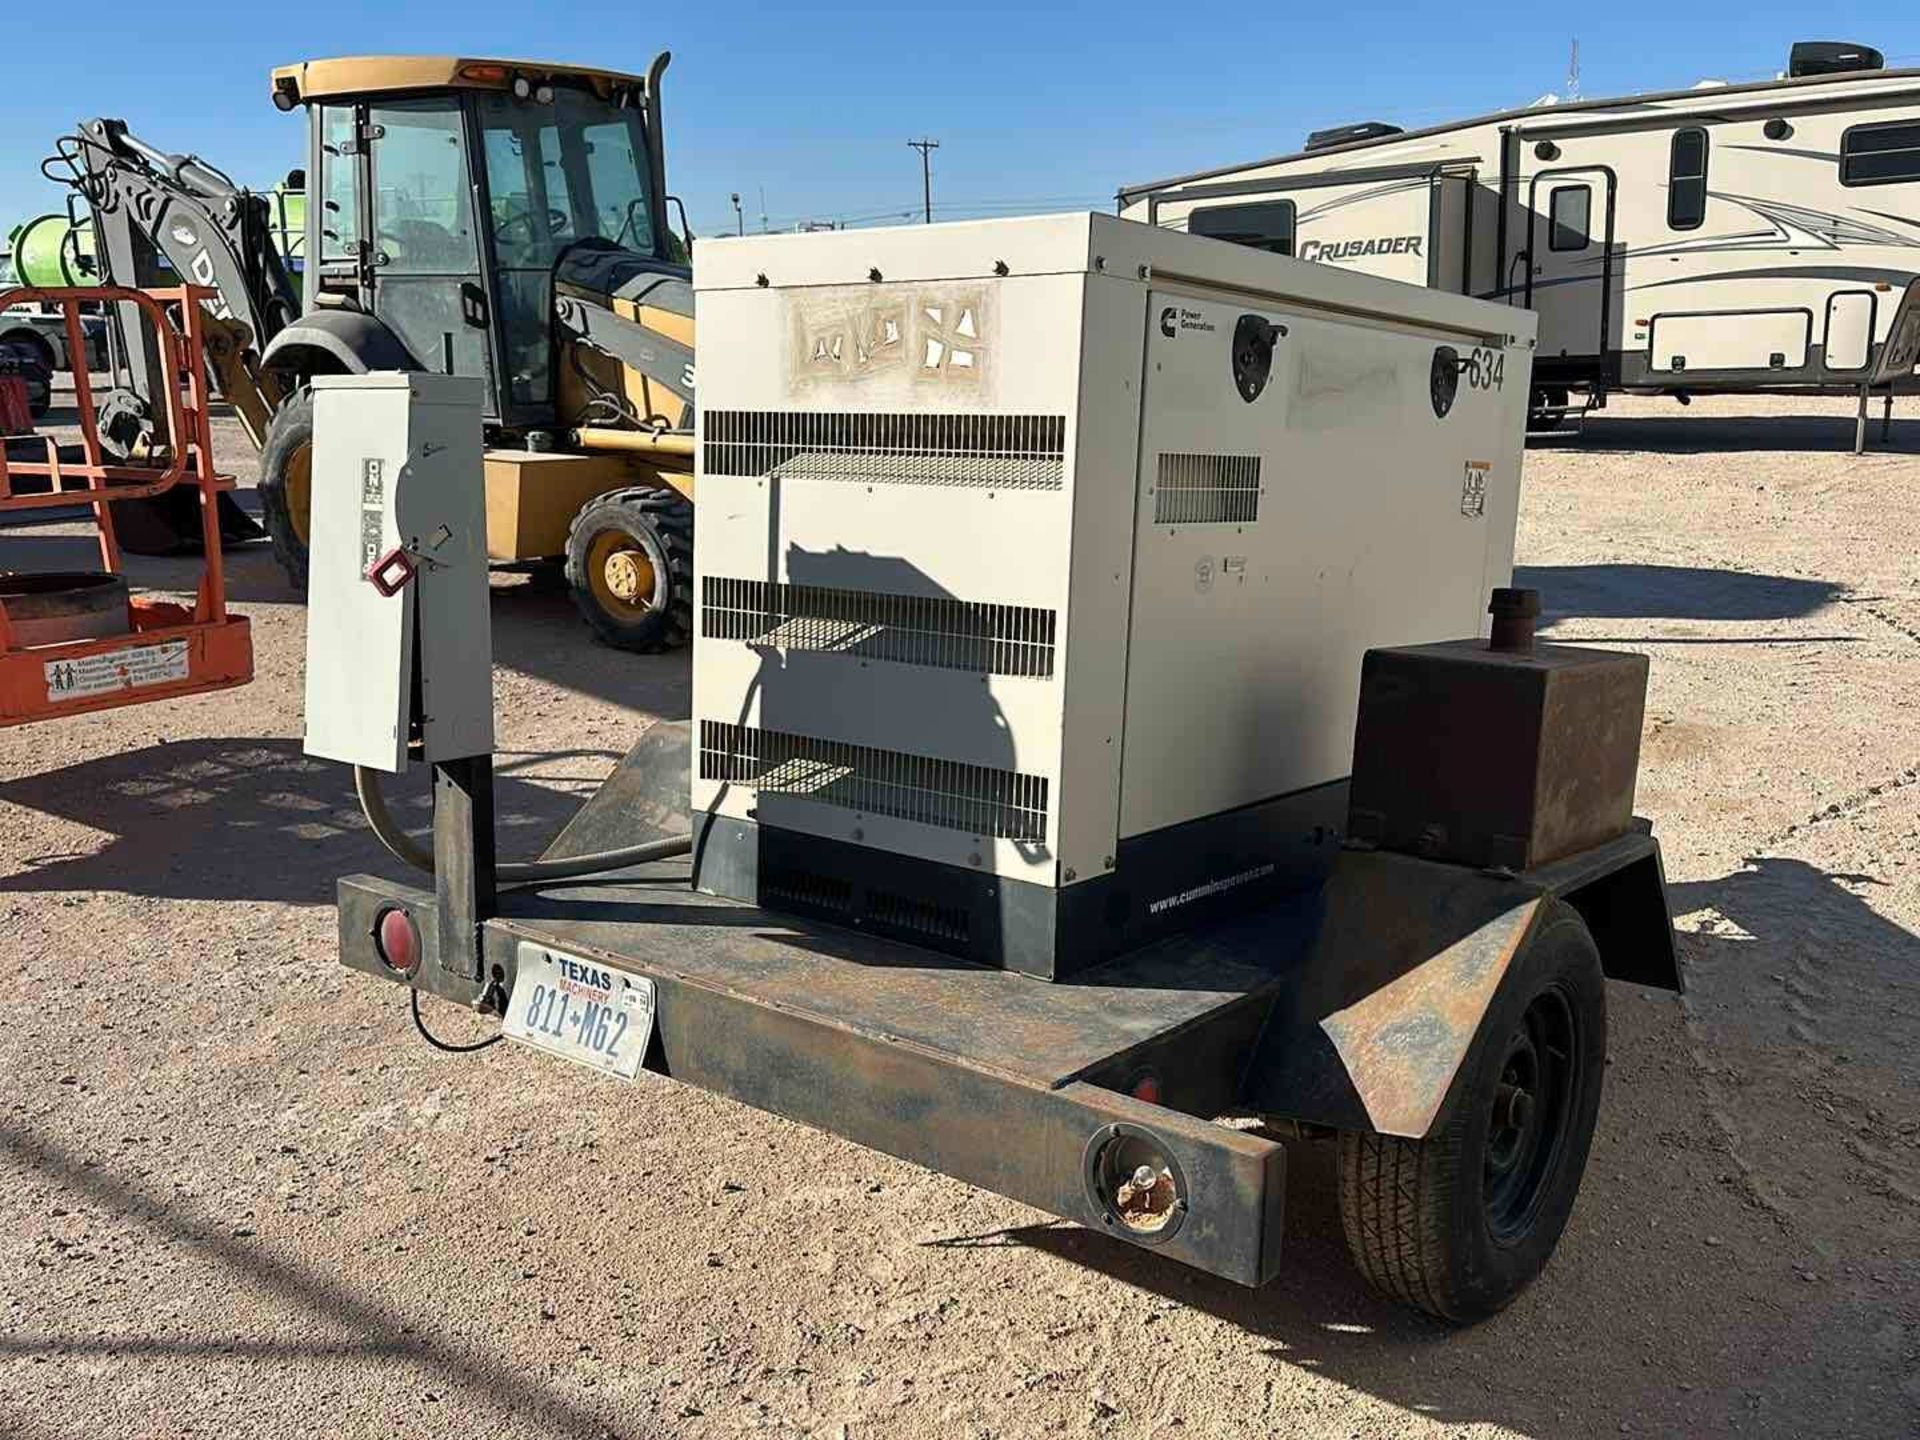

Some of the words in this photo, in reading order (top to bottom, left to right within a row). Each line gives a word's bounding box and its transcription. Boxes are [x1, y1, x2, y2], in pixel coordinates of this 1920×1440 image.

[1301, 236, 1424, 262] CRUSADER
[1181, 308, 1202, 320] Power
[1181, 320, 1215, 332] Generation
[1469, 347, 1504, 392] 634
[558, 958, 611, 991] TEXAS
[557, 978, 610, 1006] MACHINERY
